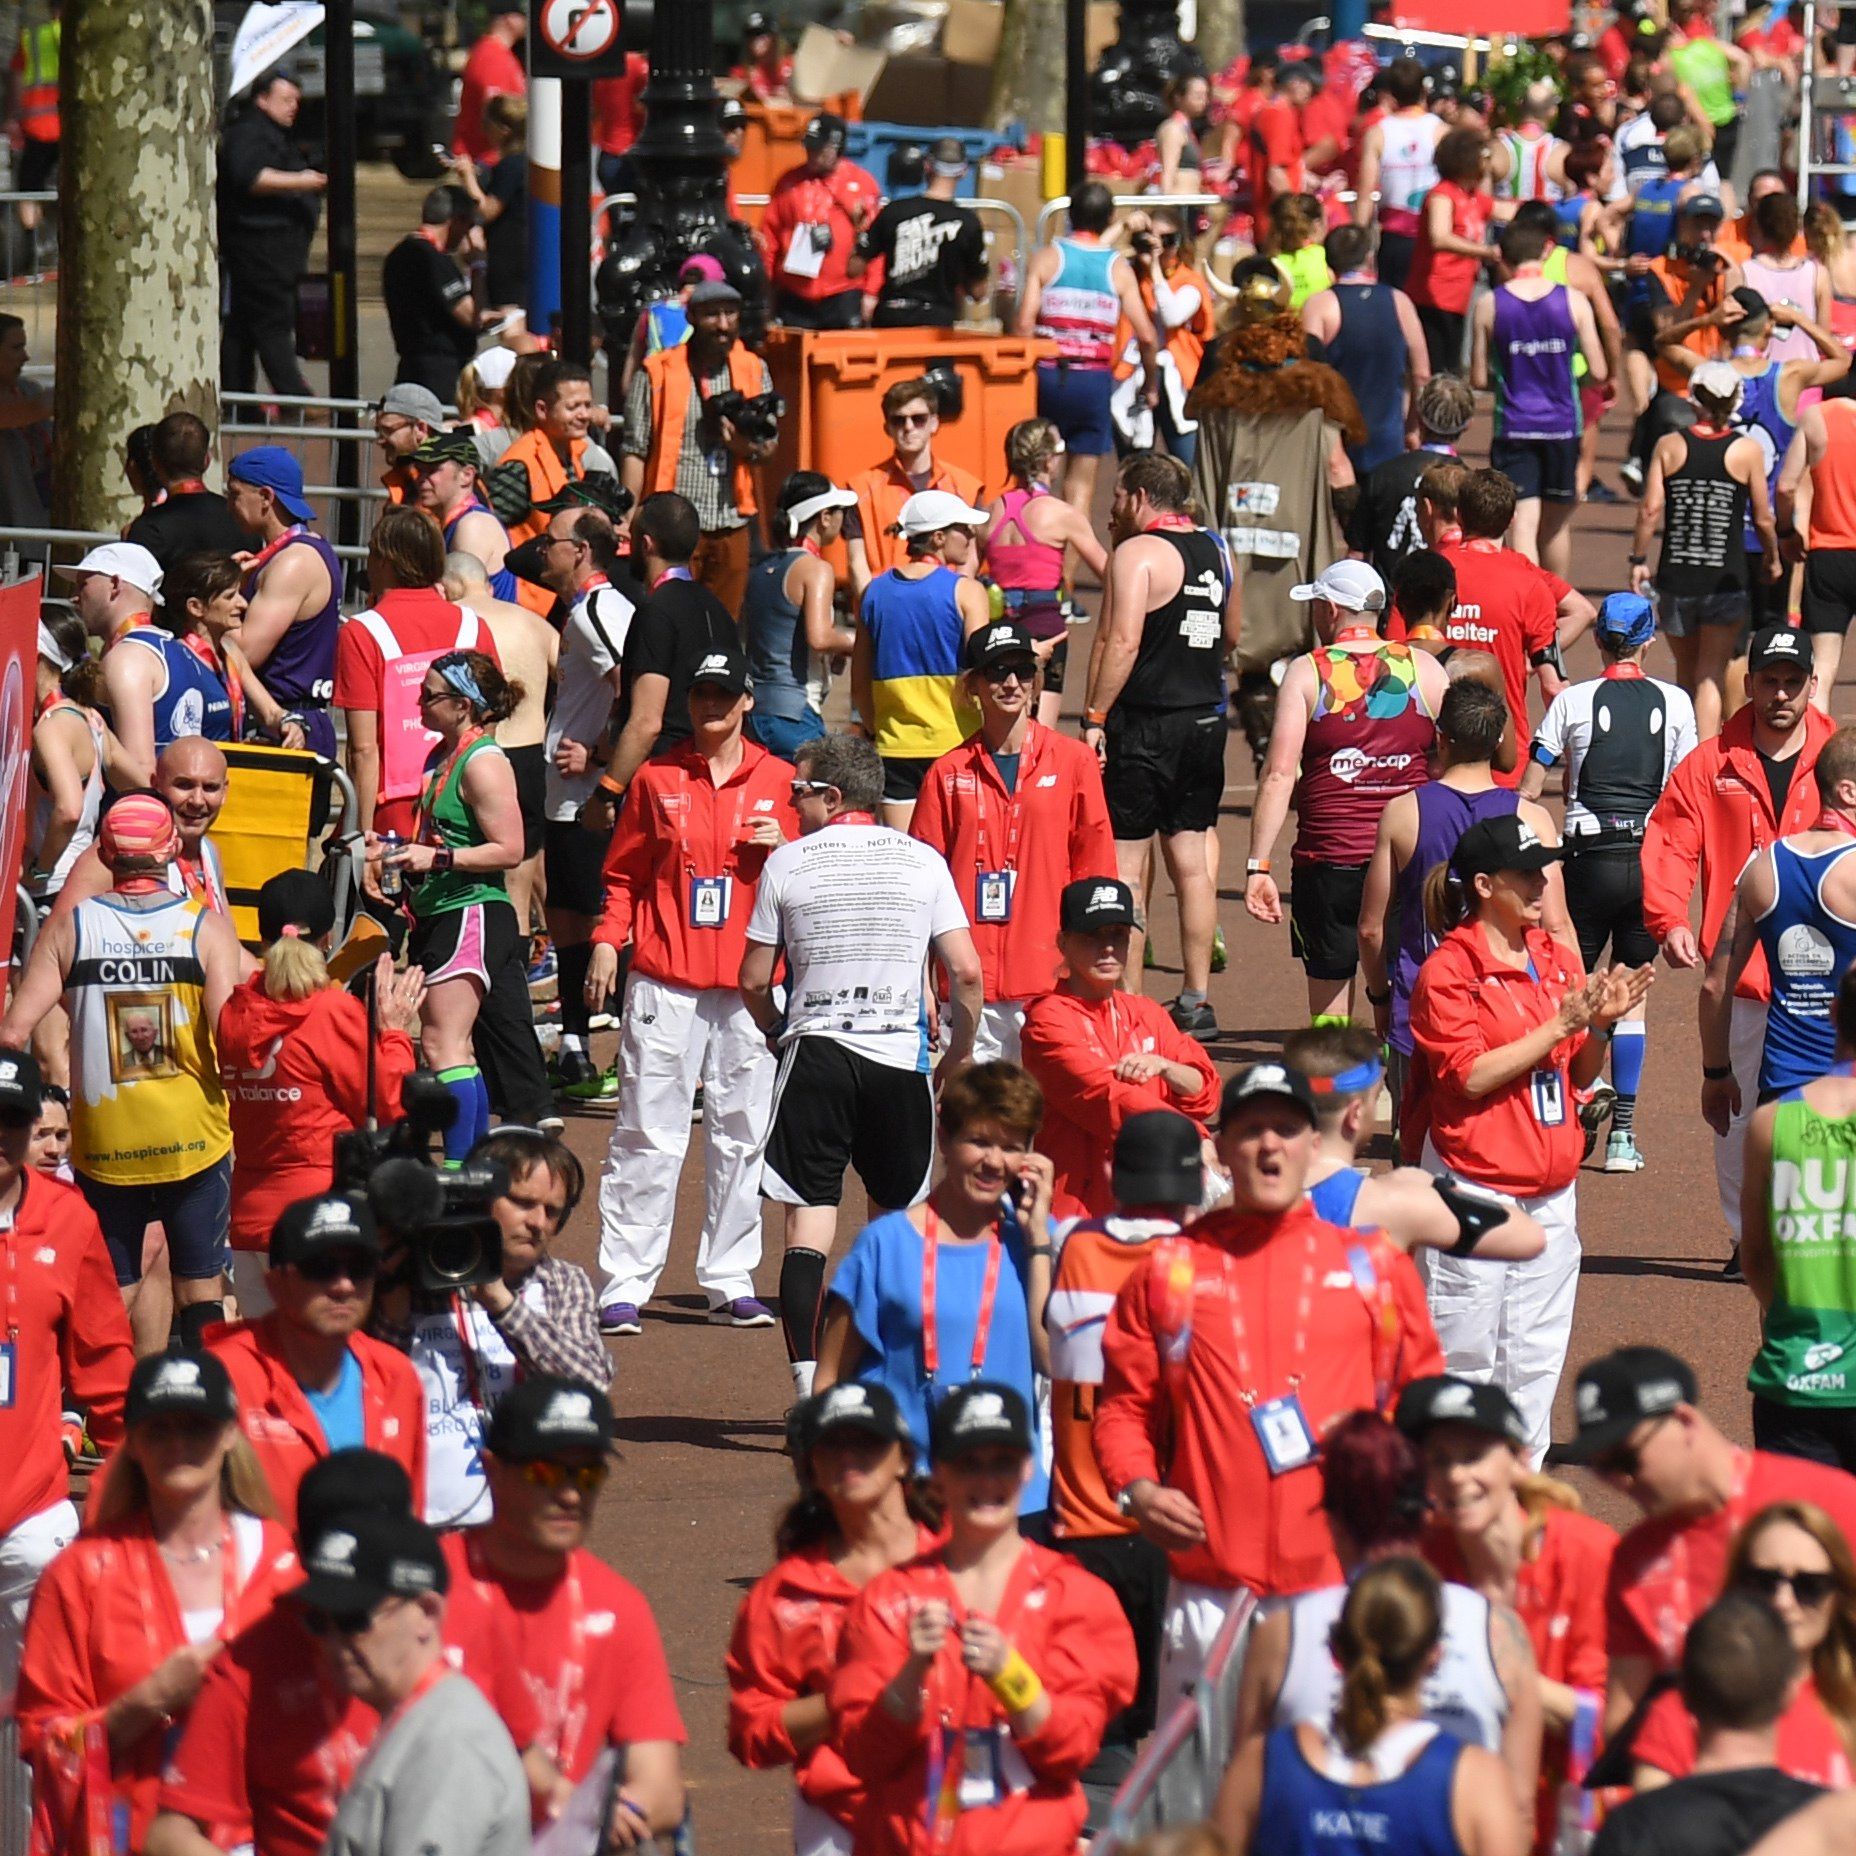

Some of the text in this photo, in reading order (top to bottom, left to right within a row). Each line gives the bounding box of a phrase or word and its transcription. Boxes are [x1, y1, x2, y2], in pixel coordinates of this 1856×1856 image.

[1331, 754, 1412, 771] mencap
[802, 841, 847, 853] Potters
[102, 939, 166, 958] hospice
[99, 959, 176, 984] COLIN
[84, 1140, 208, 1164] www.hospiceuk.org
[1786, 1372, 1845, 1392] OXFAM
